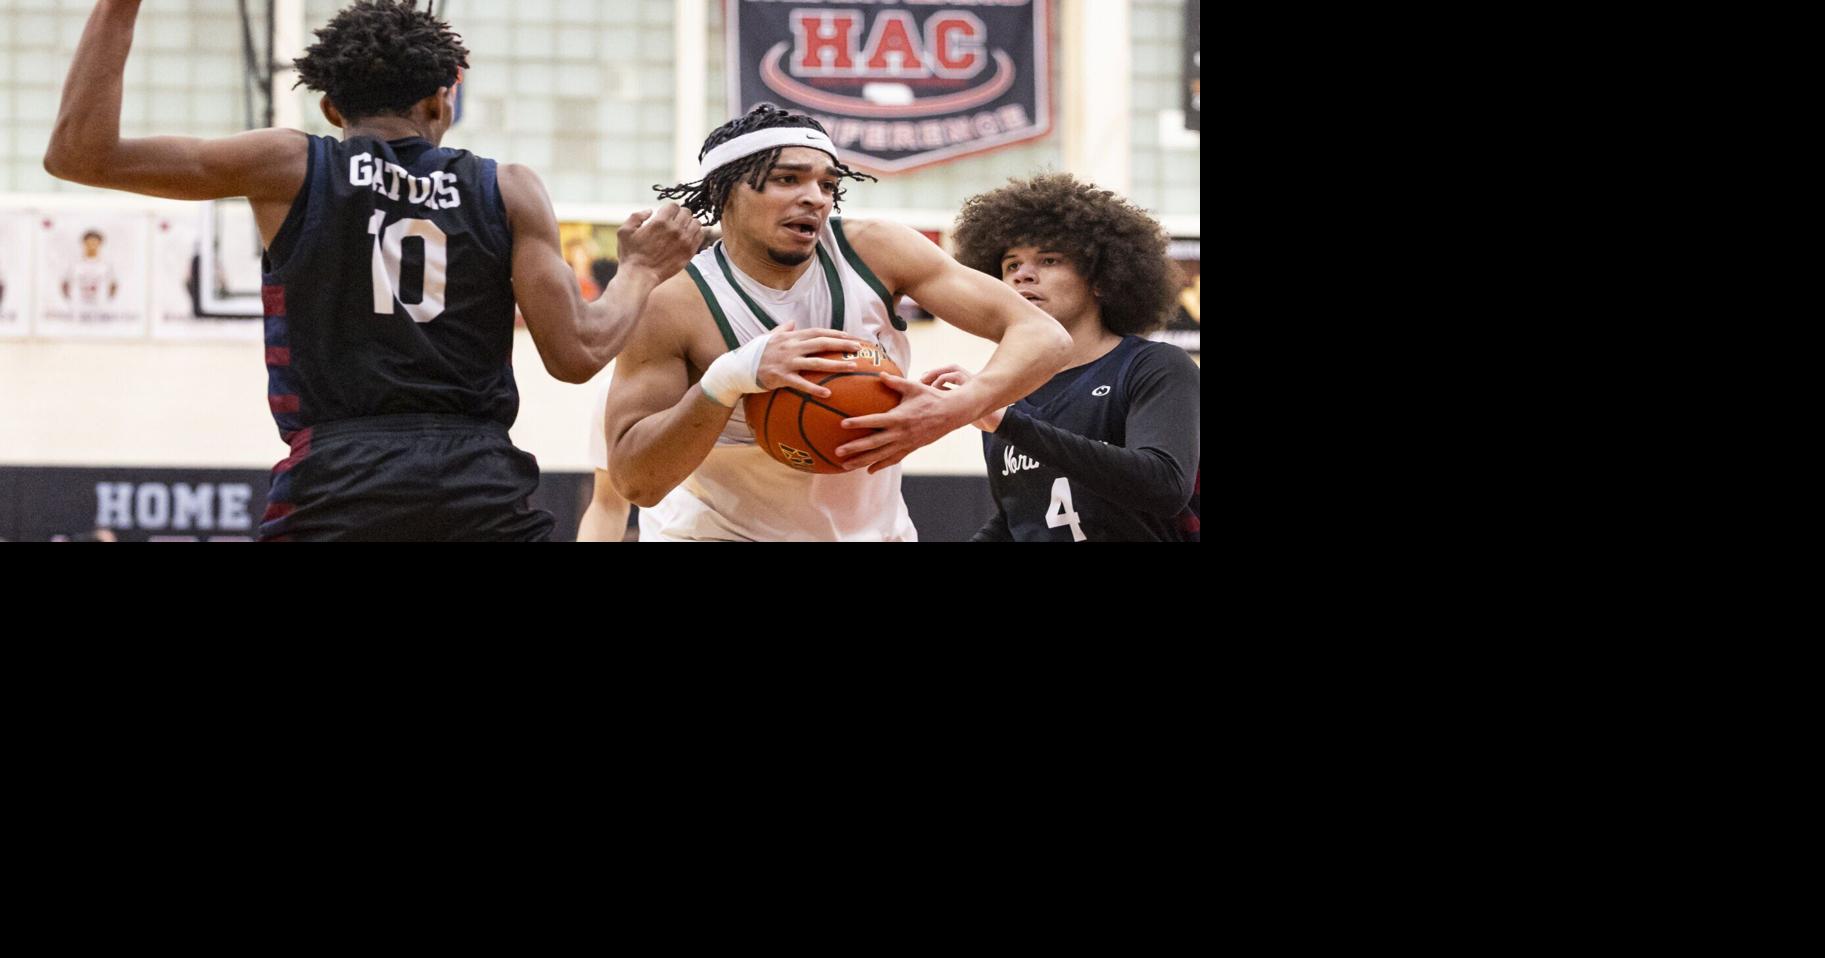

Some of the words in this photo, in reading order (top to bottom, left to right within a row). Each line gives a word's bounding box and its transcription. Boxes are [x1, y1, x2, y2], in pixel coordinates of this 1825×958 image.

[789, 8, 987, 79] HAC
[368, 208, 447, 323] 10
[95, 482, 252, 529] HOME
[1045, 477, 1087, 541] 4
